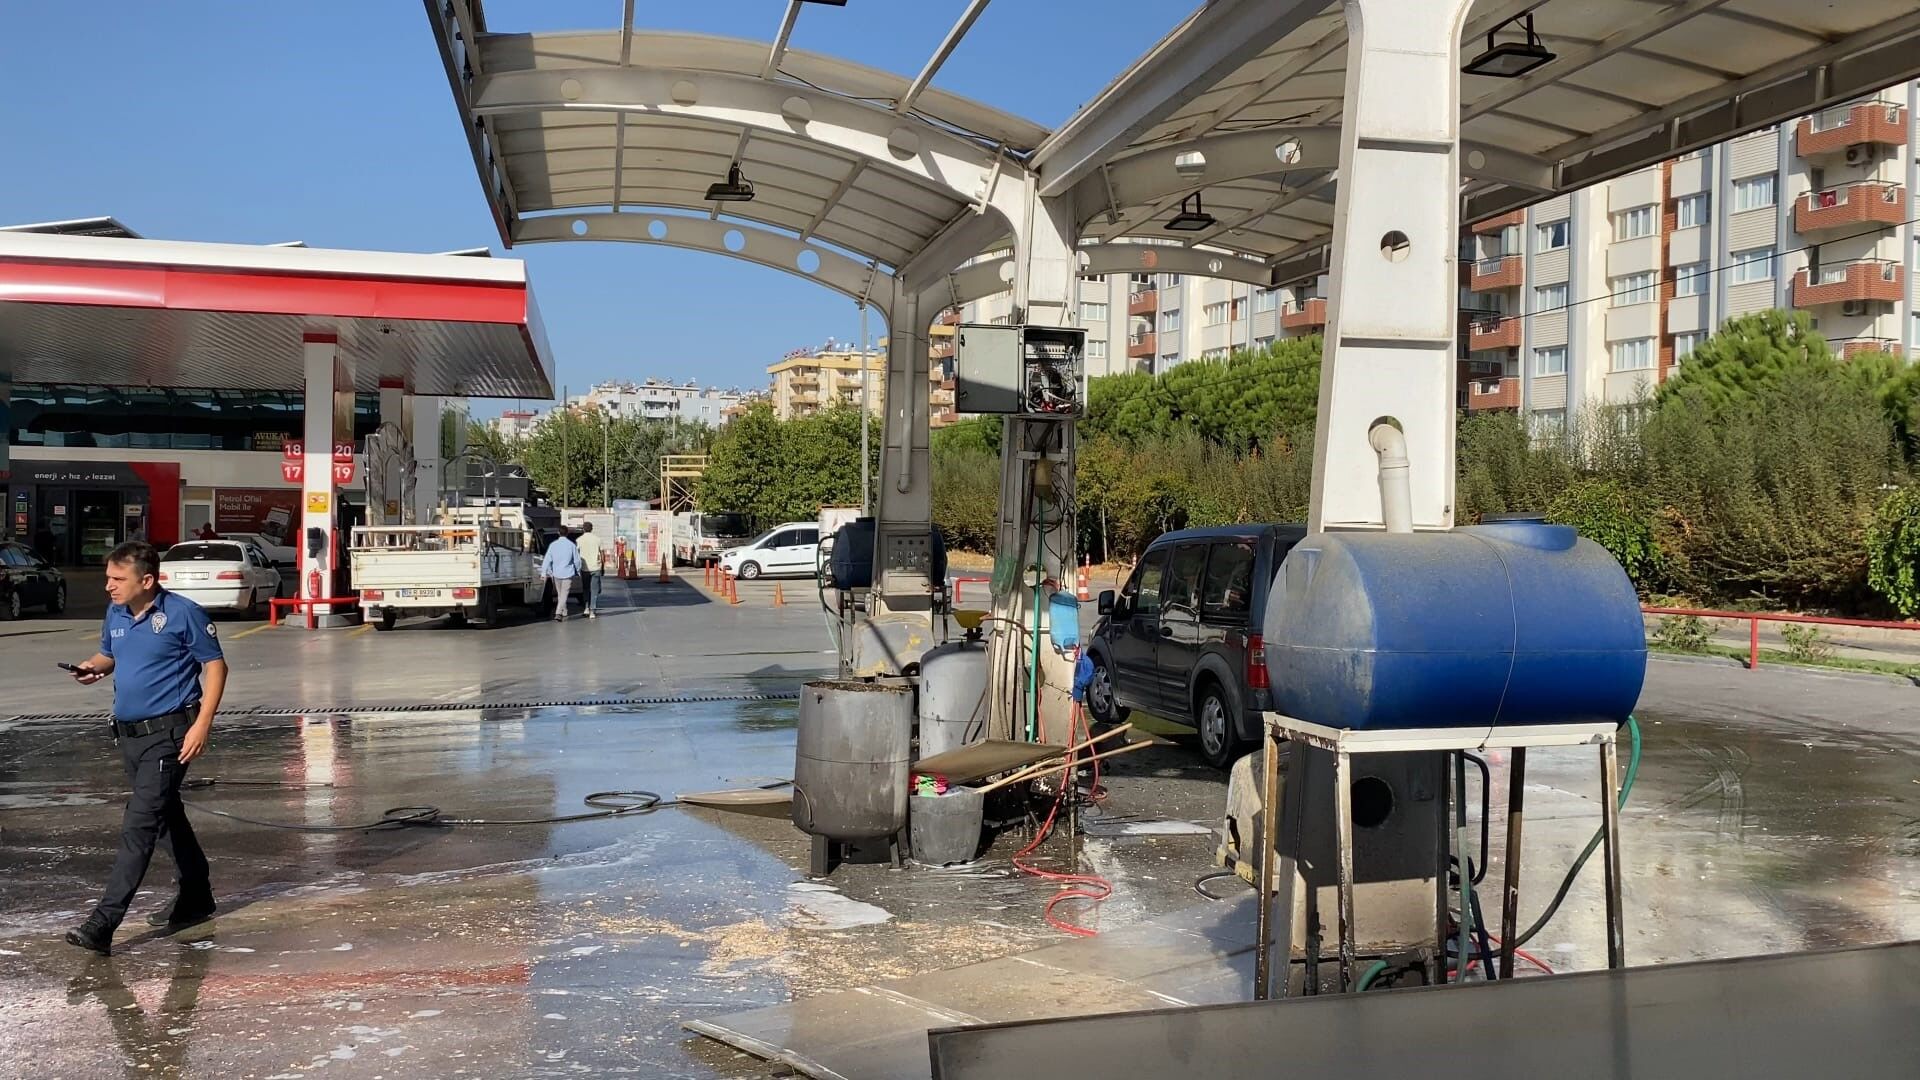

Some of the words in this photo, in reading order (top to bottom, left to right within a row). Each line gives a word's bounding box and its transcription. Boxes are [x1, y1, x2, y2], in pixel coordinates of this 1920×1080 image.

[254, 432, 290, 440] AVUKAT
[285, 444, 301, 456] 18
[335, 445, 351, 457] 20
[34, 472, 58, 480] enerji
[284, 466, 301, 479] 17
[334, 467, 351, 479] 19
[219, 495, 242, 503] Petrol
